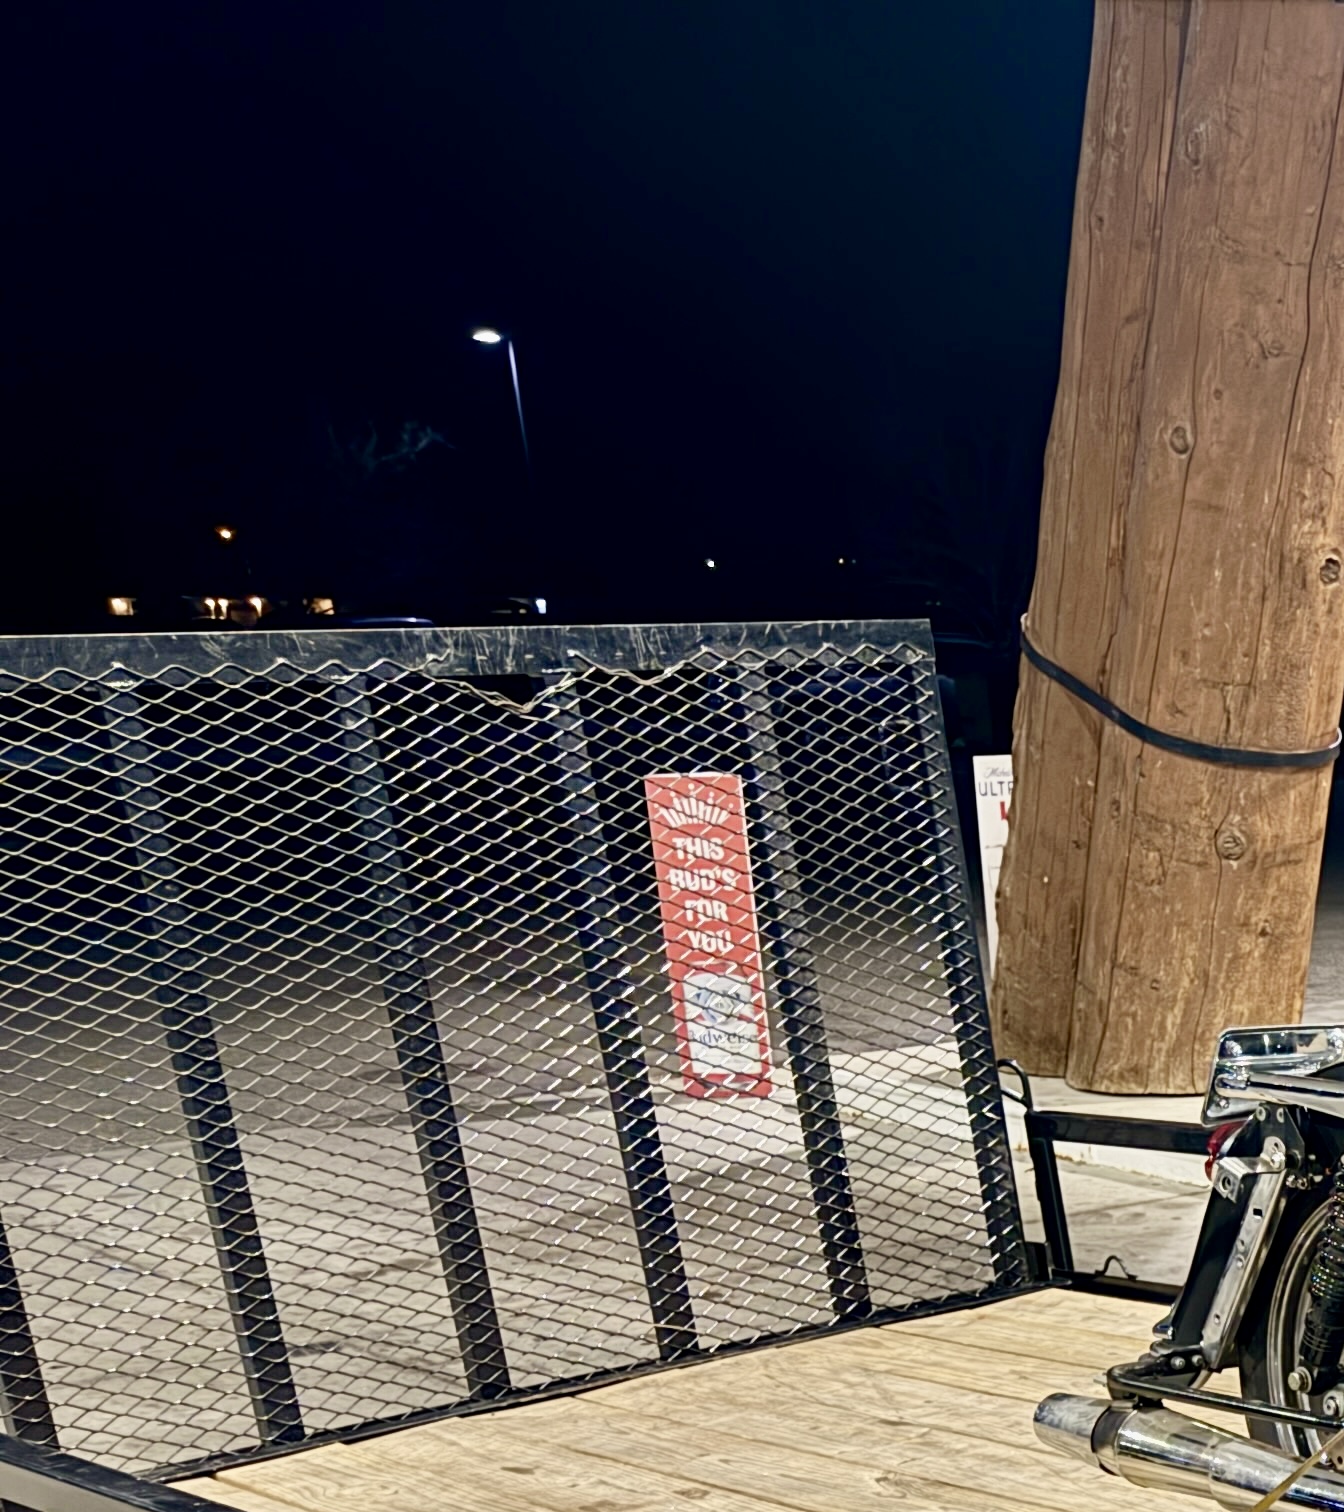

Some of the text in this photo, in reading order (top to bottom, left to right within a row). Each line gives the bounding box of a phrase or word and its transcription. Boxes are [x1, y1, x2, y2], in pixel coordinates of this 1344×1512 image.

[978, 781, 1013, 797] ULTR
[672, 837, 725, 860] THIS
[669, 868, 736, 891] BUD'S
[684, 900, 729, 922] FOR
[688, 930, 732, 953] YOU
